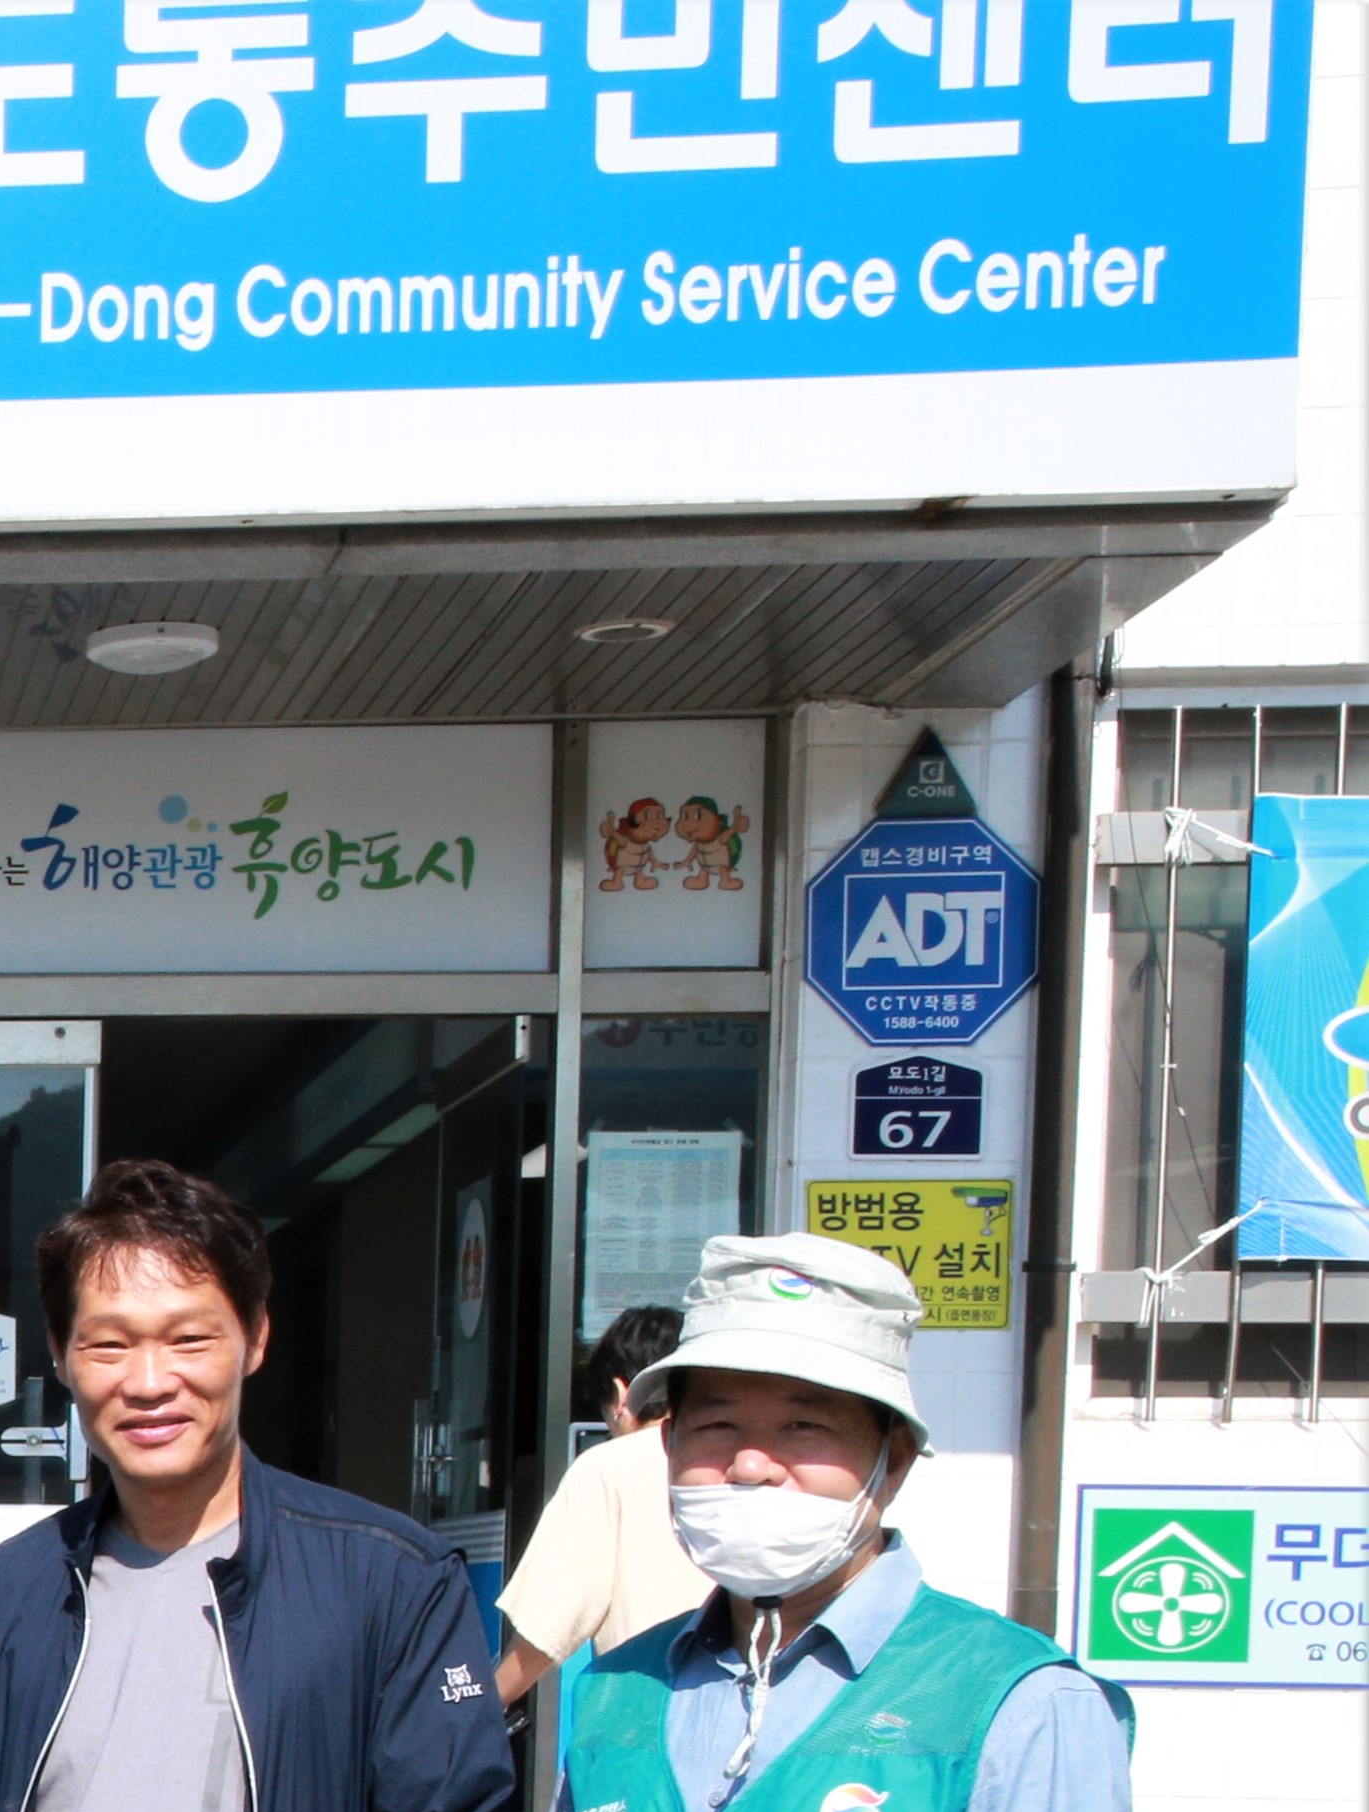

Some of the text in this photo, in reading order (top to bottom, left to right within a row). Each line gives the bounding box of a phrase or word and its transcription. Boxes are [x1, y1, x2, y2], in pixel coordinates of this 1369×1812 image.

[236, 255, 622, 341] Community
[641, 246, 896, 327] Service
[918, 233, 1166, 313] Center
[844, 891, 1004, 968] ADT
[883, 1015, 960, 1029] 1588-6400
[879, 1110, 952, 1149] 67
[817, 1191, 924, 1231] 방범용
[933, 1241, 1001, 1278] 설치
[440, 1683, 483, 1703] Lynx
